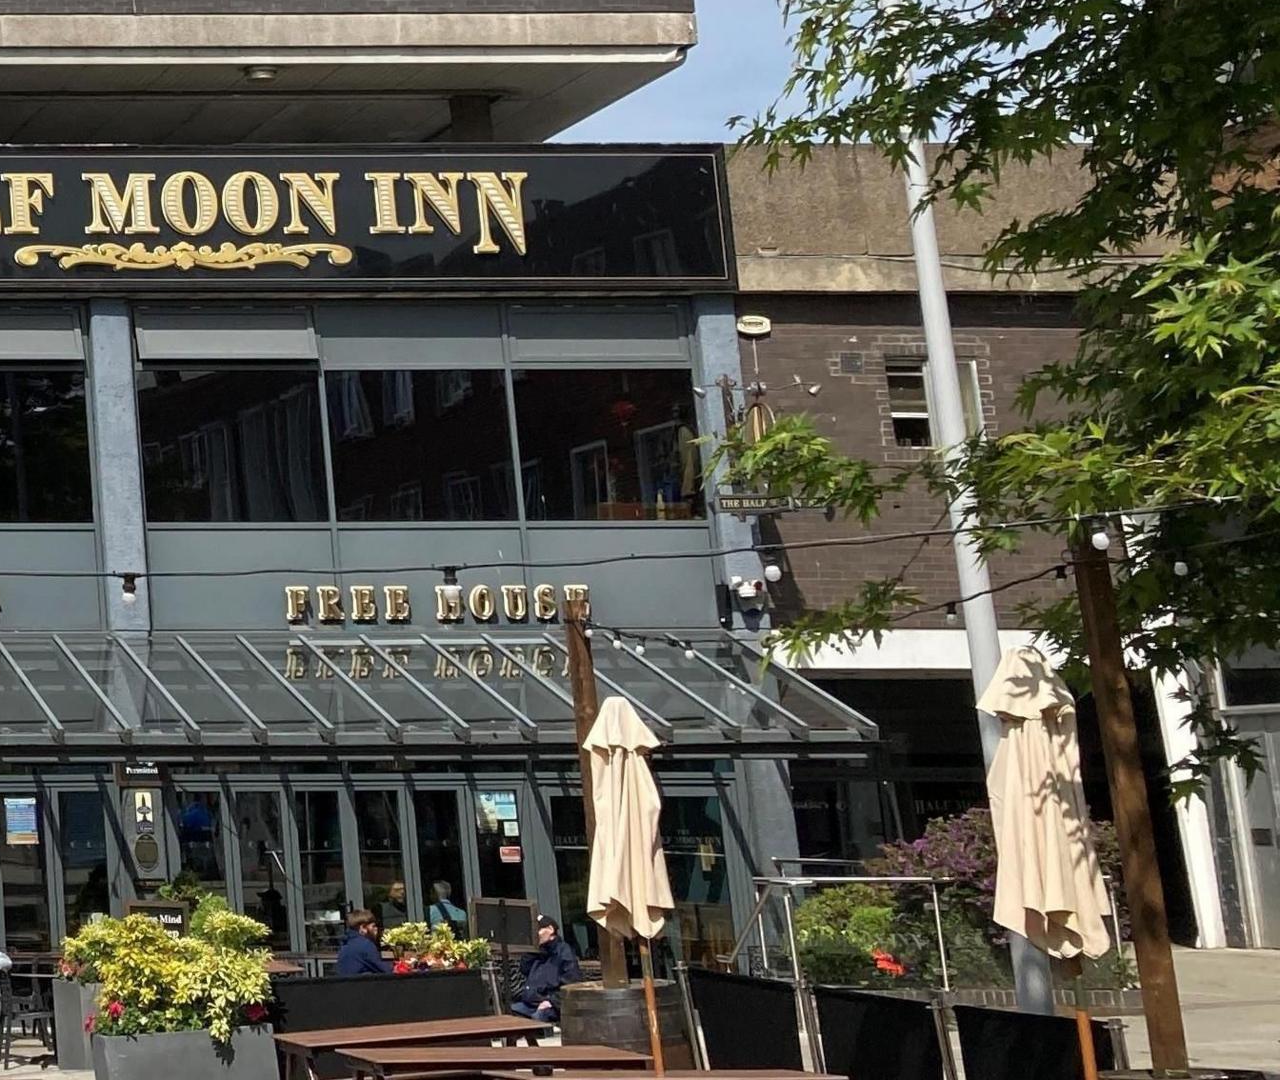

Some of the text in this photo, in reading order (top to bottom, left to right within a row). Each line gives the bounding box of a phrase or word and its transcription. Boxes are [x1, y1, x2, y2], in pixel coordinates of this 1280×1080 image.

[82, 170, 340, 236] MOON
[364, 170, 529, 257] INN
[721, 499, 740, 508] THE
[284, 585, 410, 621] FREE
[159, 914, 182, 924] Mind
